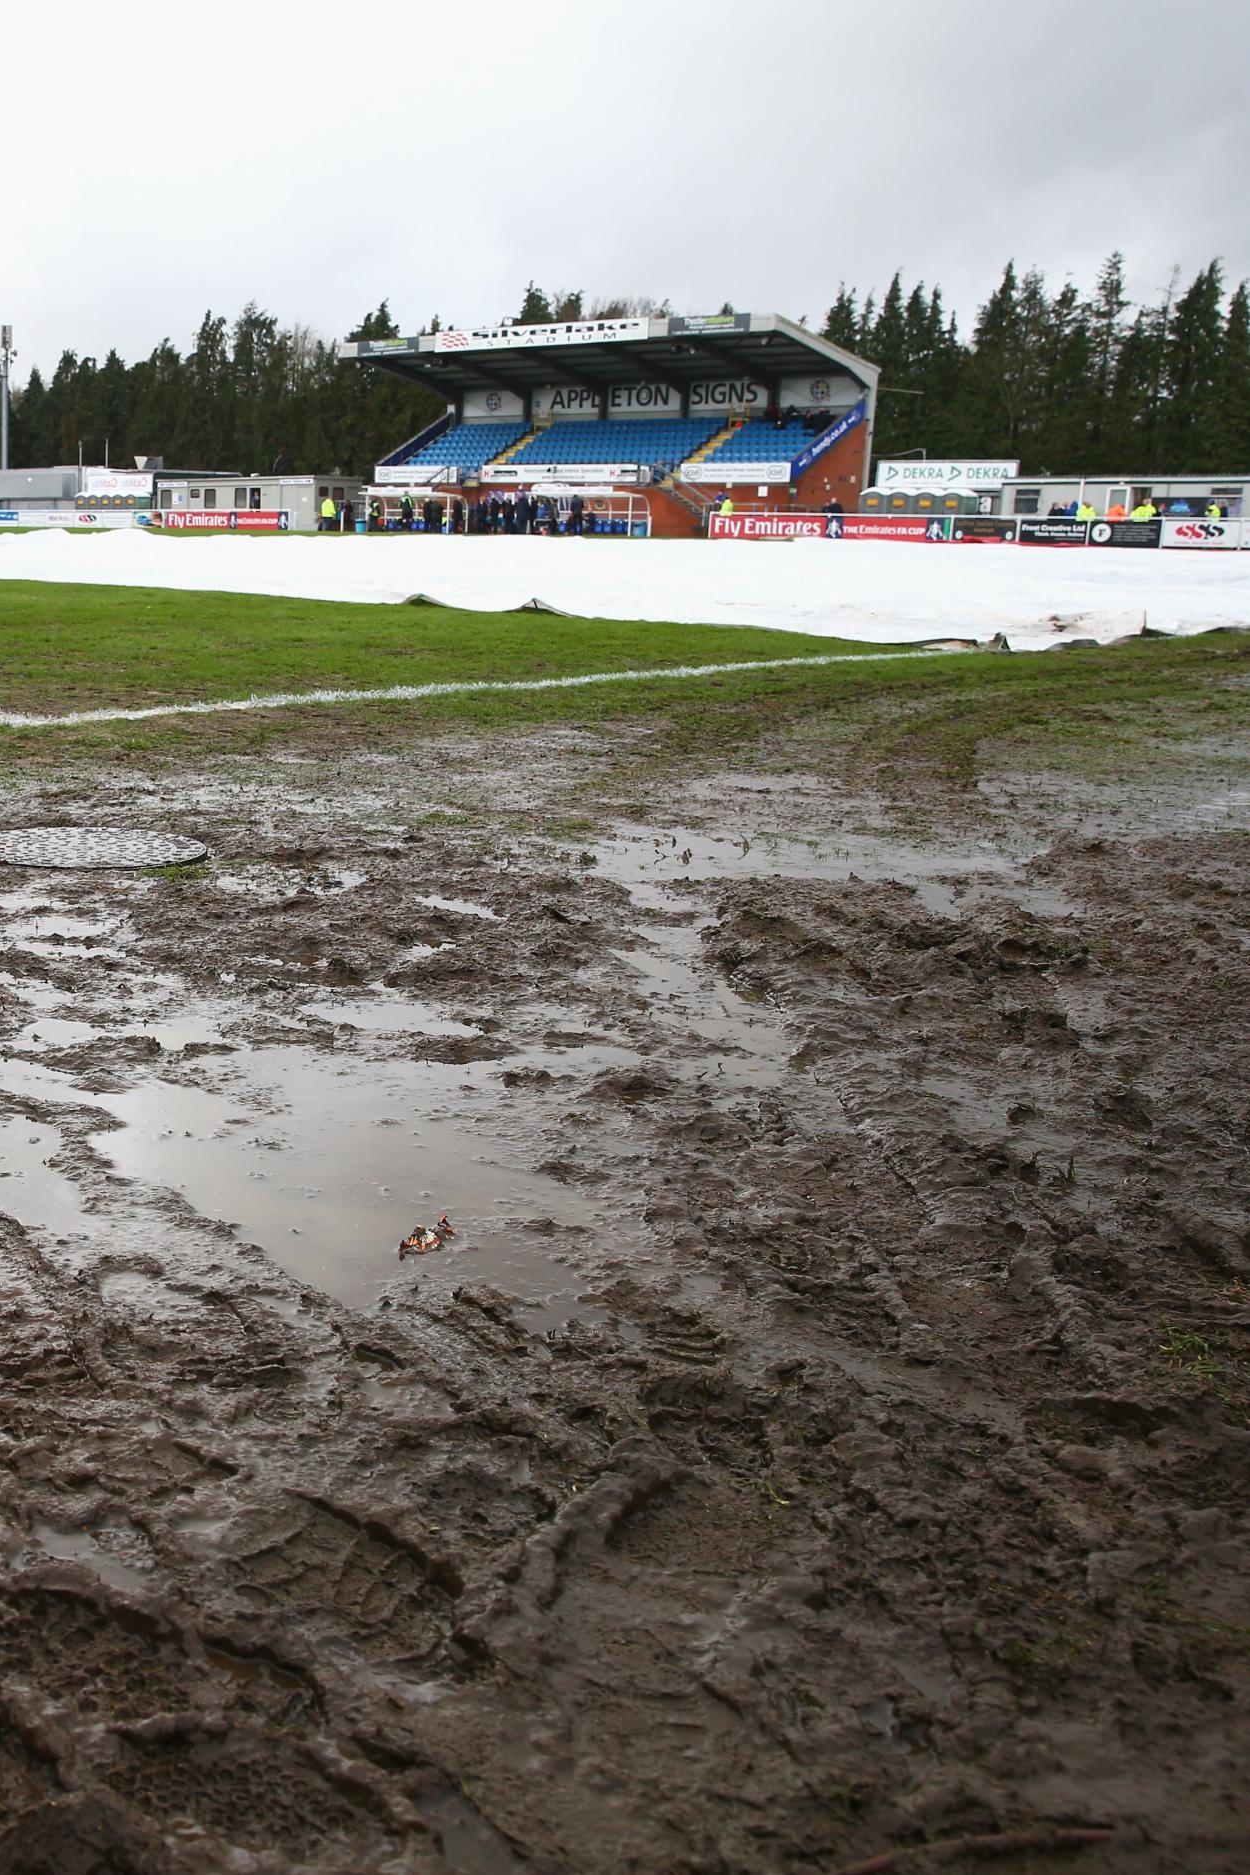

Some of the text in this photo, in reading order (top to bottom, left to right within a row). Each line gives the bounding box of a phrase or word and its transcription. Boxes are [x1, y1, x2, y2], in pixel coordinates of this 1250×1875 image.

[487, 332, 617, 347] STADIUM
[691, 382, 759, 406] SIGNS
[903, 467, 1009, 479] DEKRA DEKRA
[168, 513, 228, 528] Fly Emirates
[714, 517, 821, 537] Fly Emirates
[1041, 523, 1072, 532] Creative
[1072, 524, 1086, 532] Ltd
[859, 524, 896, 534] Emirates
[897, 527, 907, 535] FA
[908, 527, 926, 536] CUP
